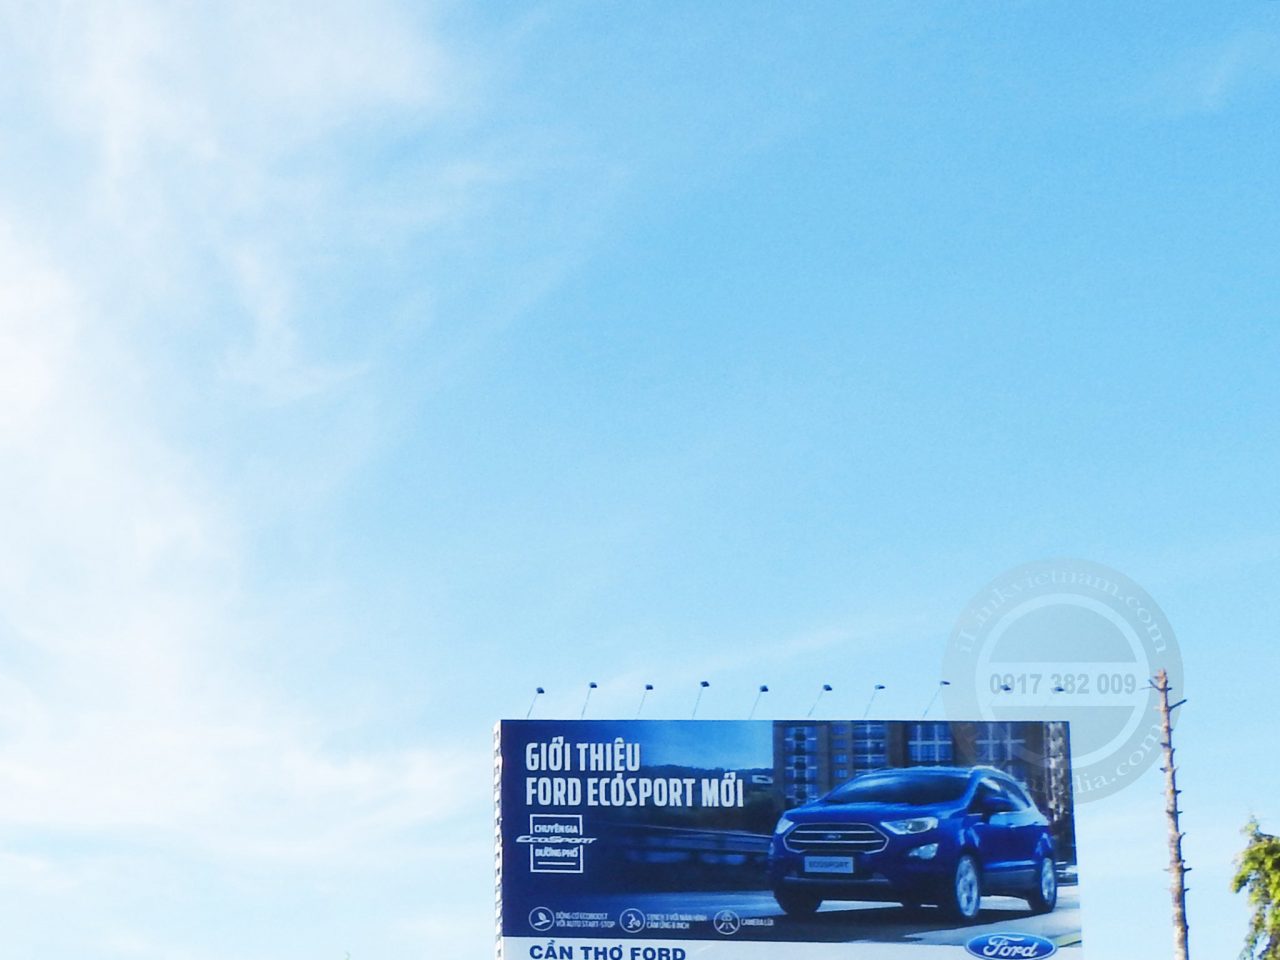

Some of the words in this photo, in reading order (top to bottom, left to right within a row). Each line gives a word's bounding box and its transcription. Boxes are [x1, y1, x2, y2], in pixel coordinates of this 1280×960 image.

[526, 736, 570, 771] GIỚI
[576, 737, 640, 774] THIỆU
[526, 777, 582, 806] FORD
[587, 777, 696, 807] ECOSPORT
[701, 772, 744, 808] MỚI
[534, 823, 564, 833] CHUYÊN
[565, 824, 578, 833] GIA
[562, 846, 579, 857] PHỐ
[529, 940, 573, 960] CẦN
[580, 944, 623, 960] THƠ
[983, 935, 1038, 957] Ford
